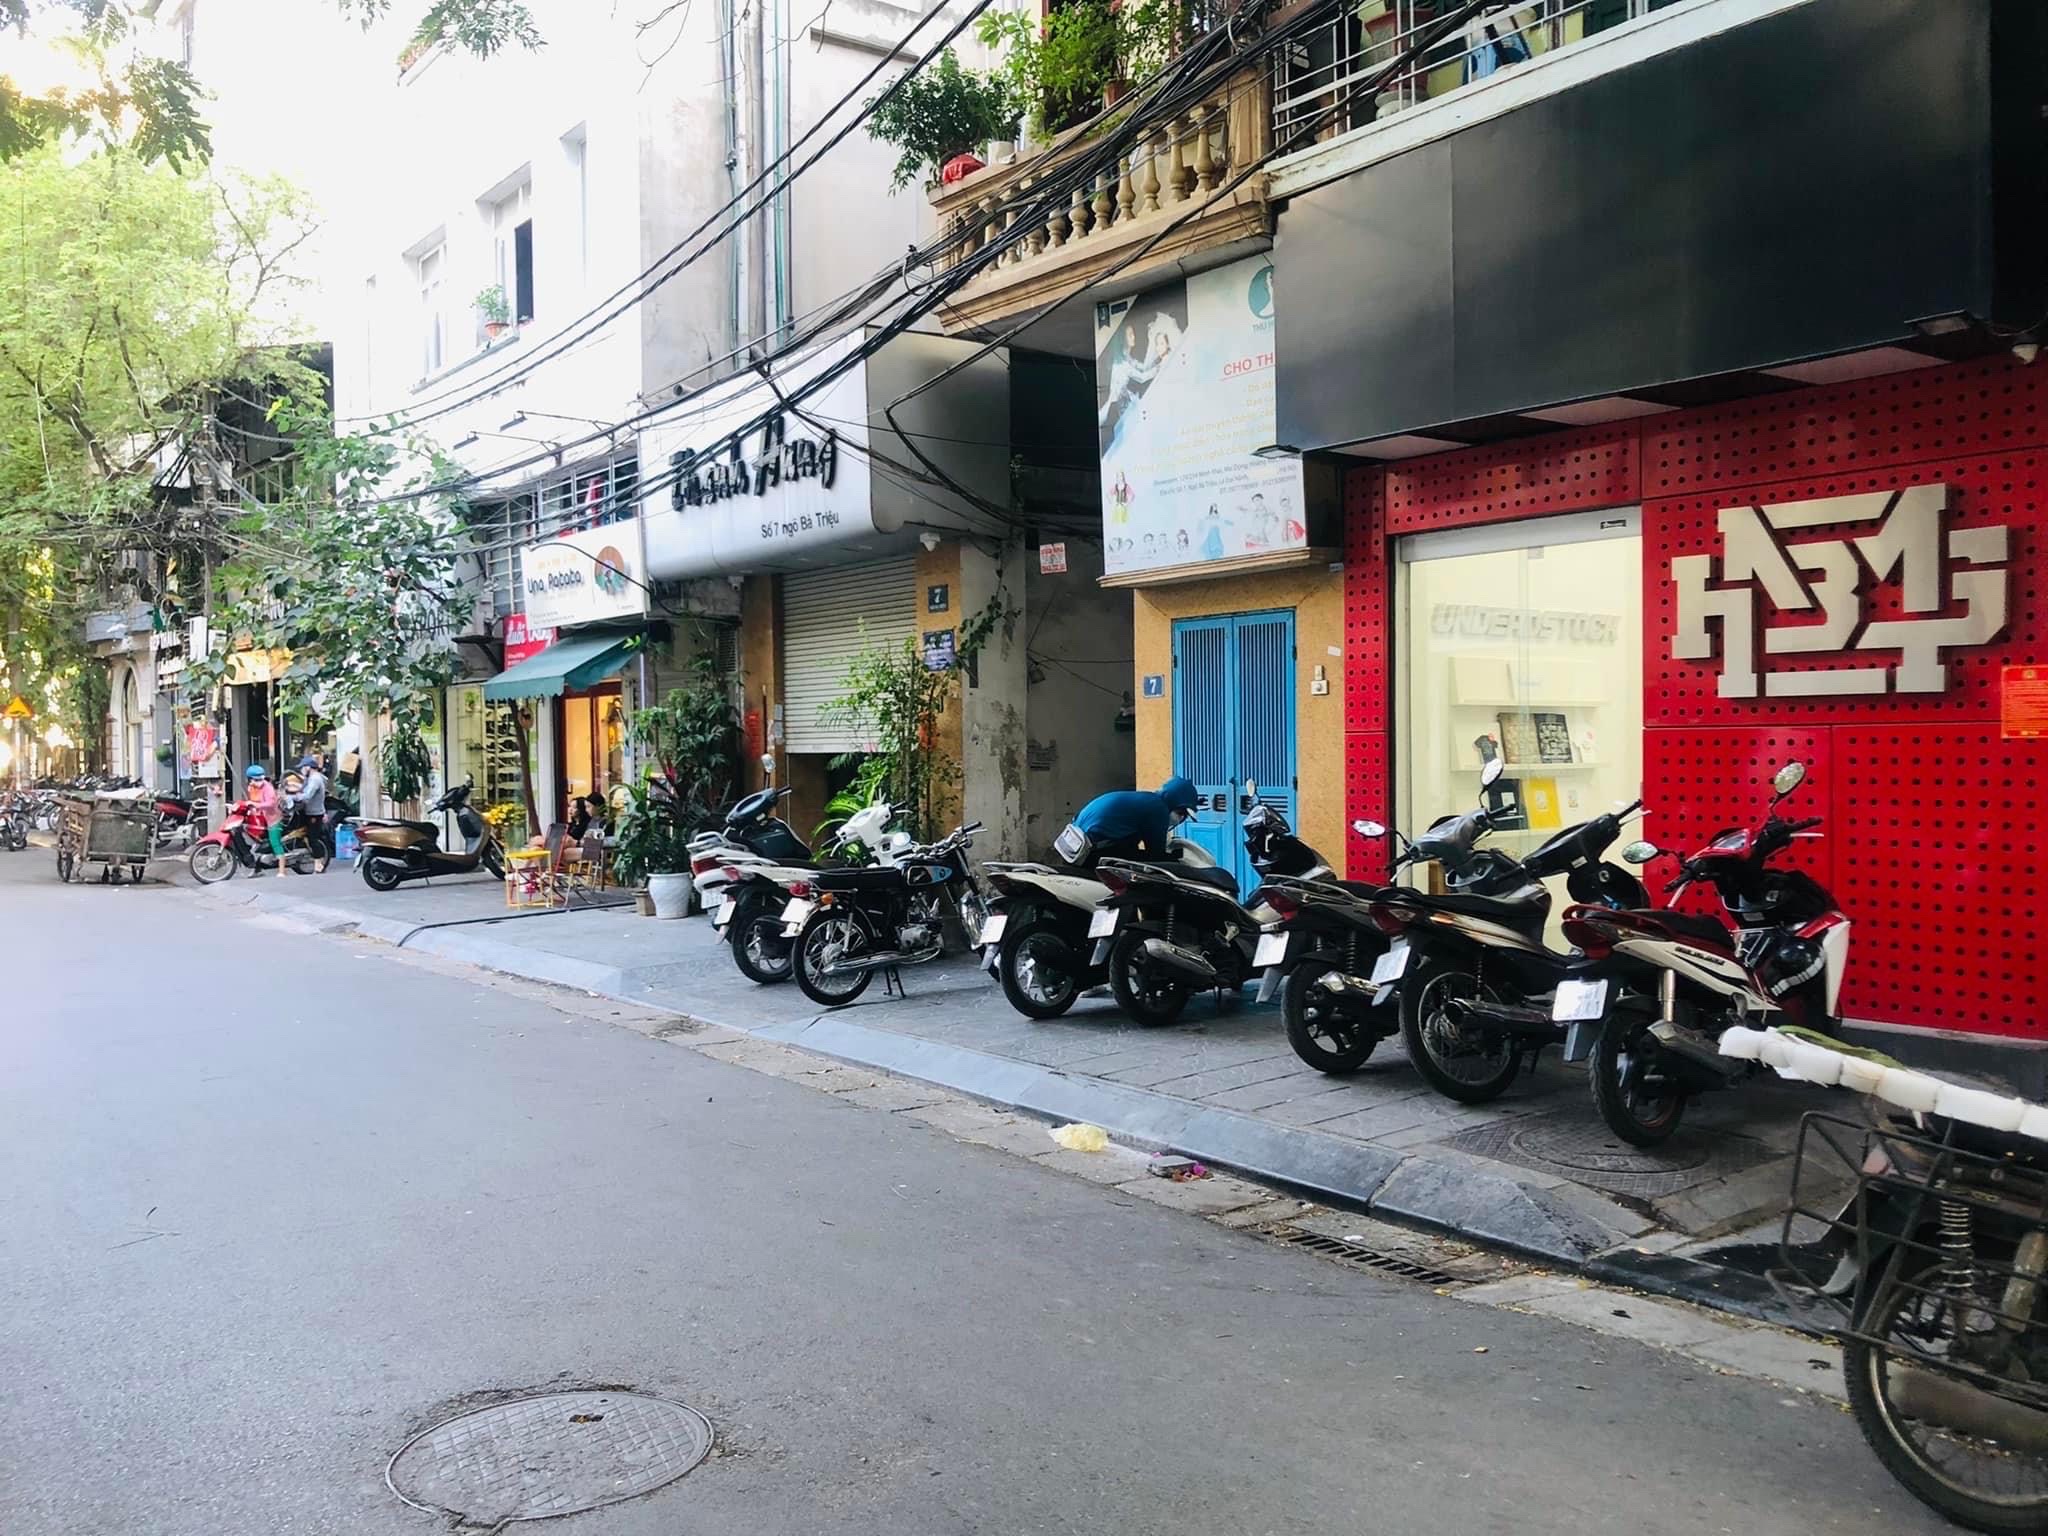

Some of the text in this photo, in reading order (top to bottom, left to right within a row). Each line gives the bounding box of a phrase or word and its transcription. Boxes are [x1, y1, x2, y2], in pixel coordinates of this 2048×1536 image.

[1223, 359, 1252, 376] CHO
[761, 521, 773, 538] Số
[774, 522, 779, 537] 7
[815, 510, 839, 528] Triệu
[934, 588, 942, 604] 7
[1149, 678, 1157, 694] 7
